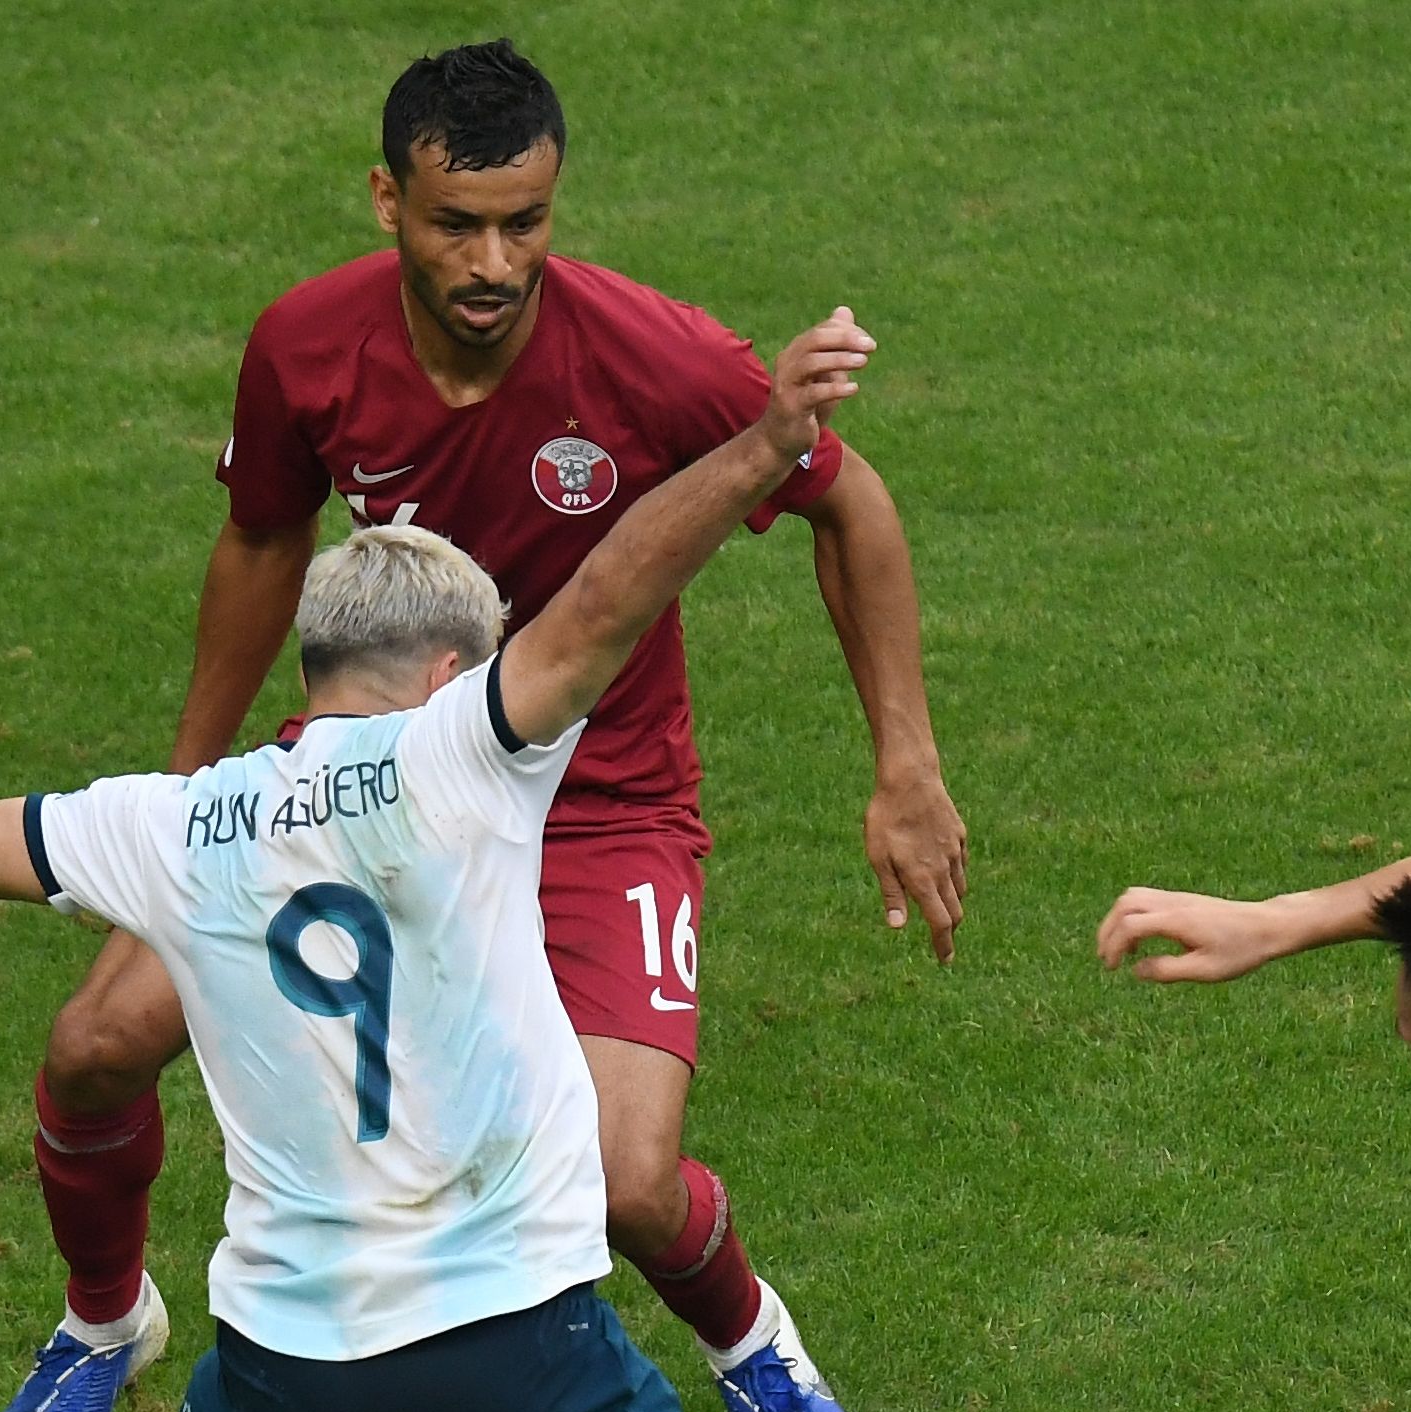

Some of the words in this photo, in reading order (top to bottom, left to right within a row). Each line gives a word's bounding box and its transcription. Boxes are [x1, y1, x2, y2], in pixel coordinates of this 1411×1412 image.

[562, 493, 592, 507] QFA
[186, 791, 261, 848] KUN
[625, 882, 698, 993] 16
[266, 882, 394, 1143] 9
